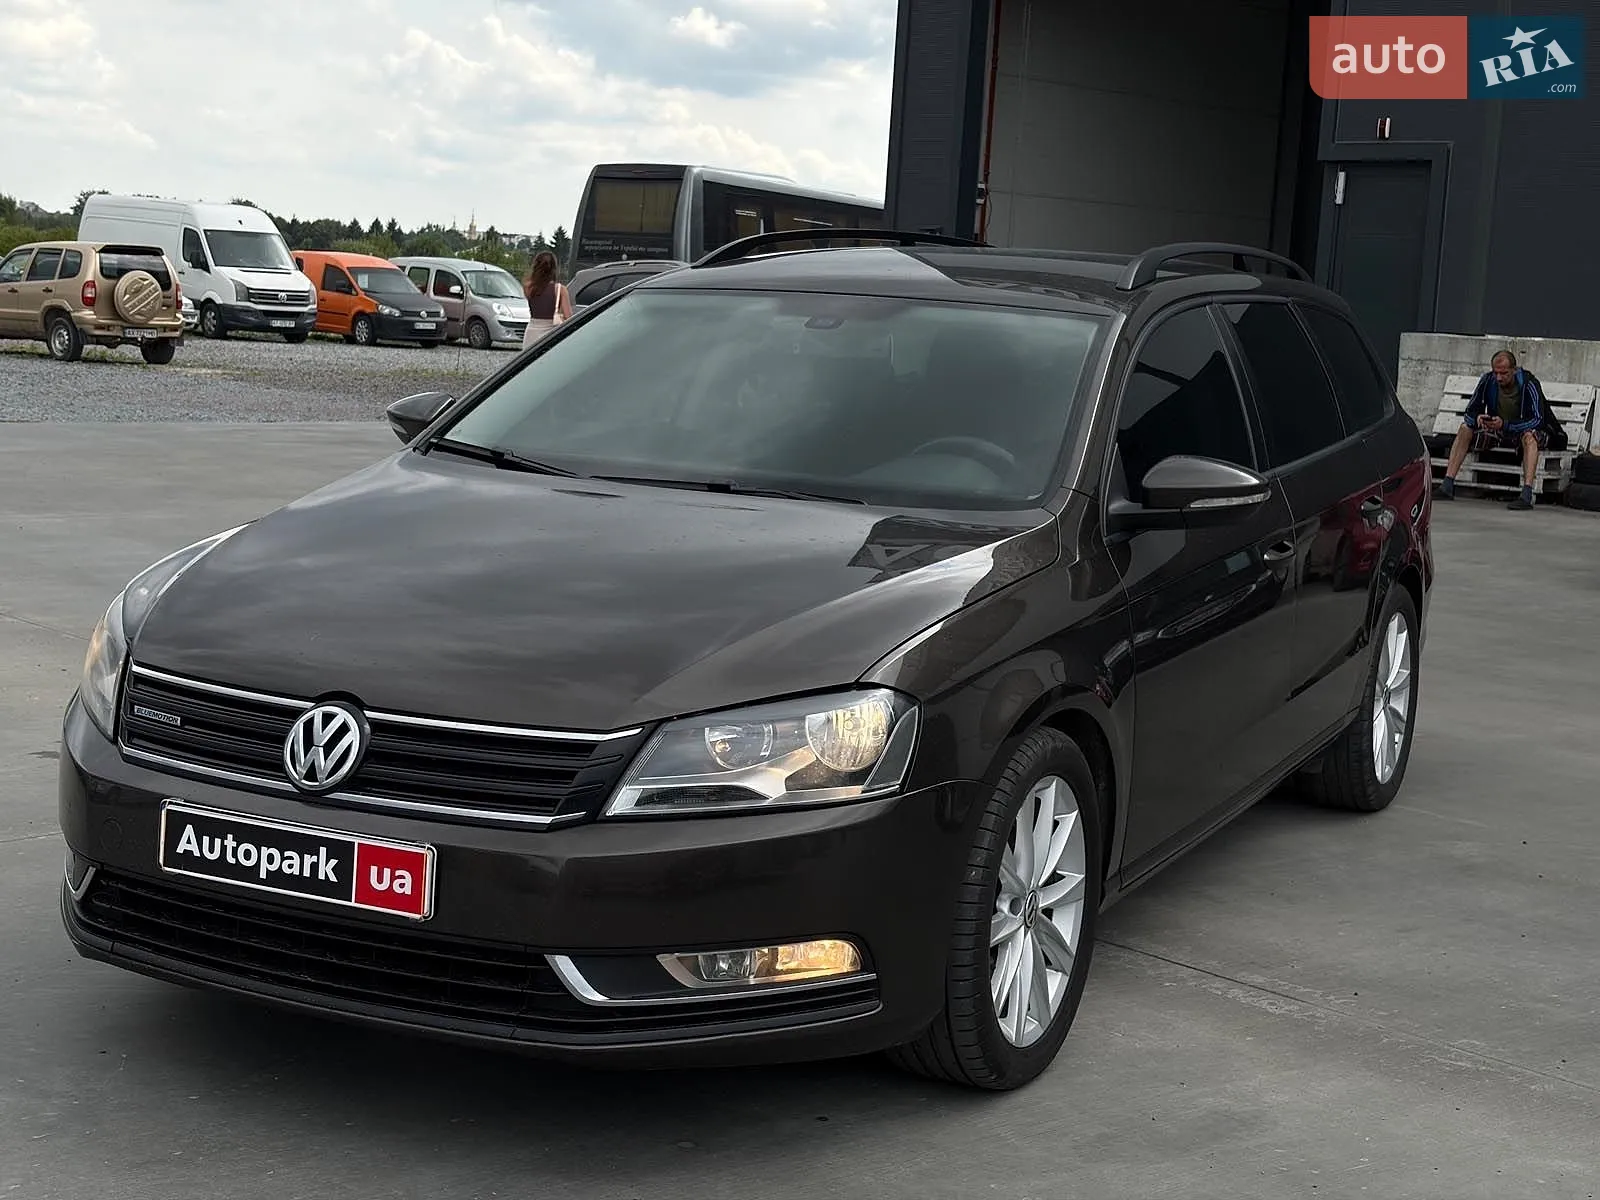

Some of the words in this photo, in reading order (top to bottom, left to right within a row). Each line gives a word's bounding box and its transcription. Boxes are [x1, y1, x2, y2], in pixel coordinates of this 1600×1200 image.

[136, 706, 179, 724] BLUEMOTION
[176, 824, 339, 883] Autopark
[369, 864, 413, 895] ua
